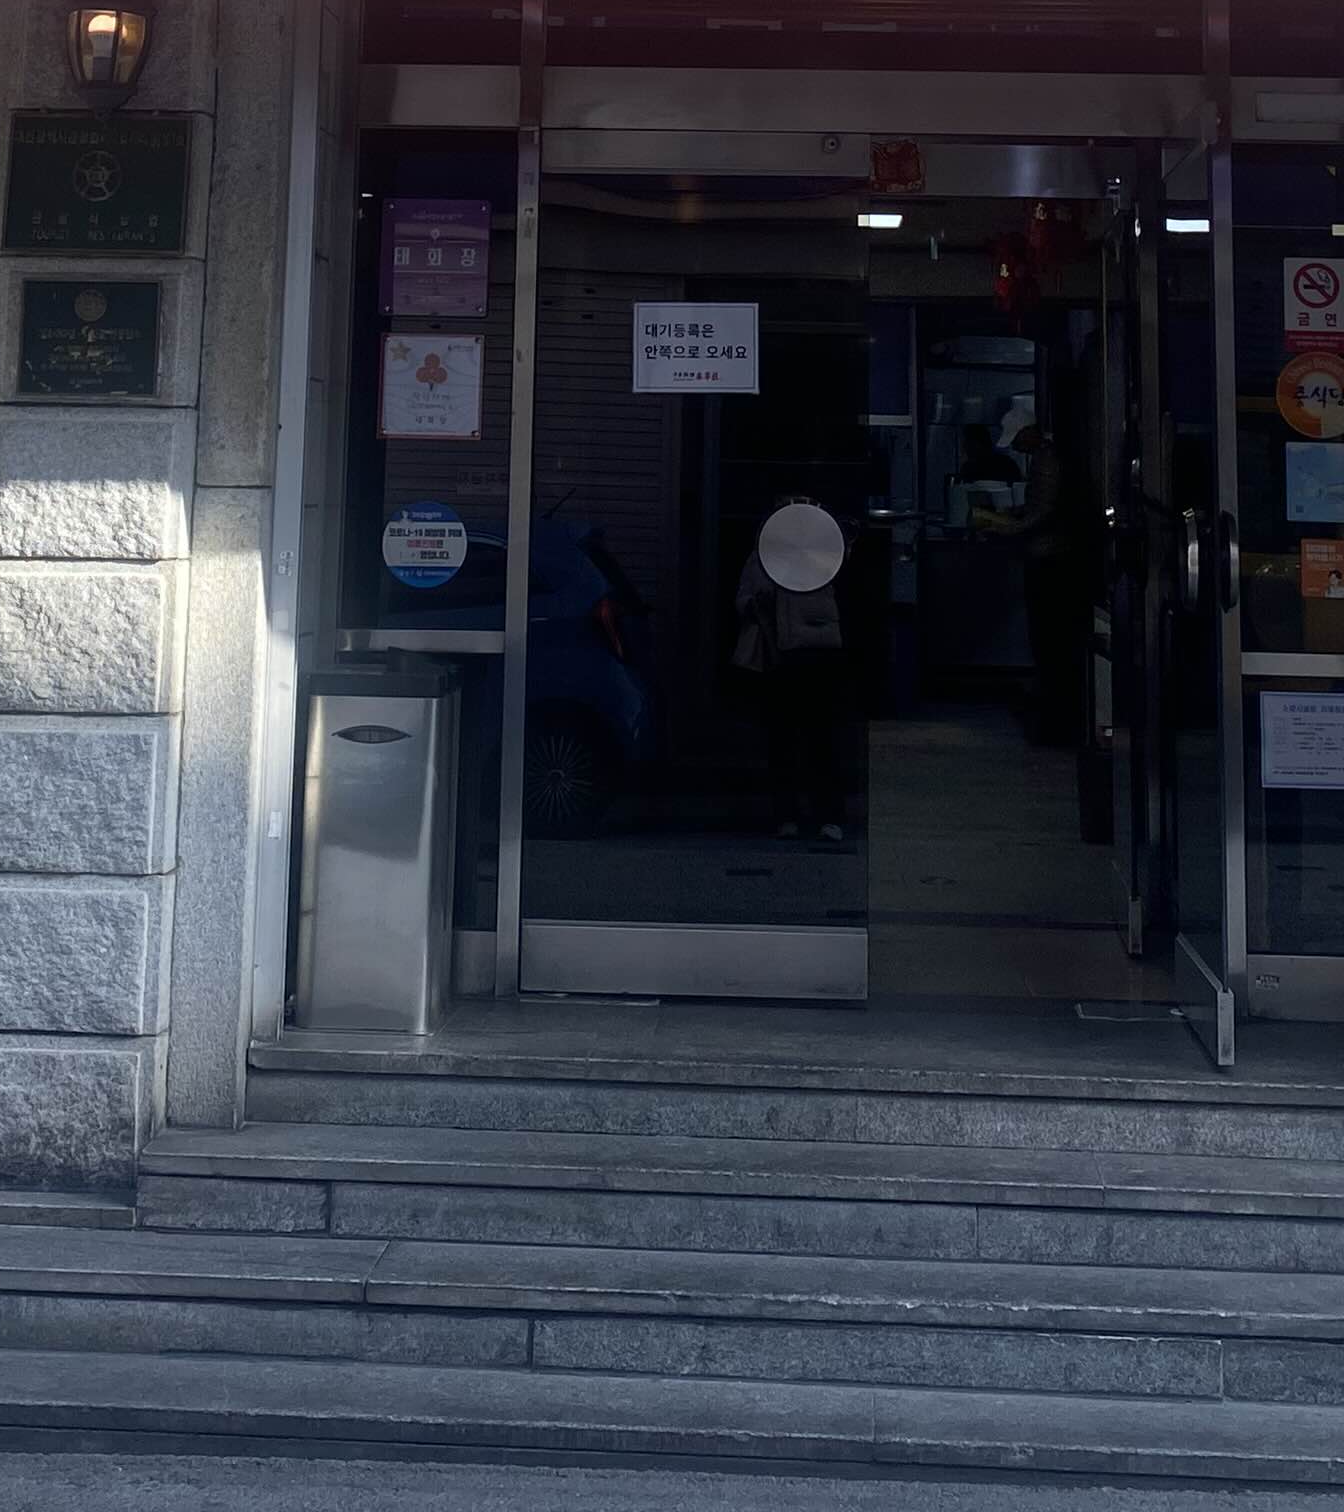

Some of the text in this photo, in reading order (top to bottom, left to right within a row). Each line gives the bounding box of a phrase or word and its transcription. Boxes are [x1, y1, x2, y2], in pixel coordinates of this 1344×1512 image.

[1297, 312, 1337, 327] 금연
[644, 323, 715, 338] 대기등록은
[644, 345, 747, 360] 안쪽으로 오세요
